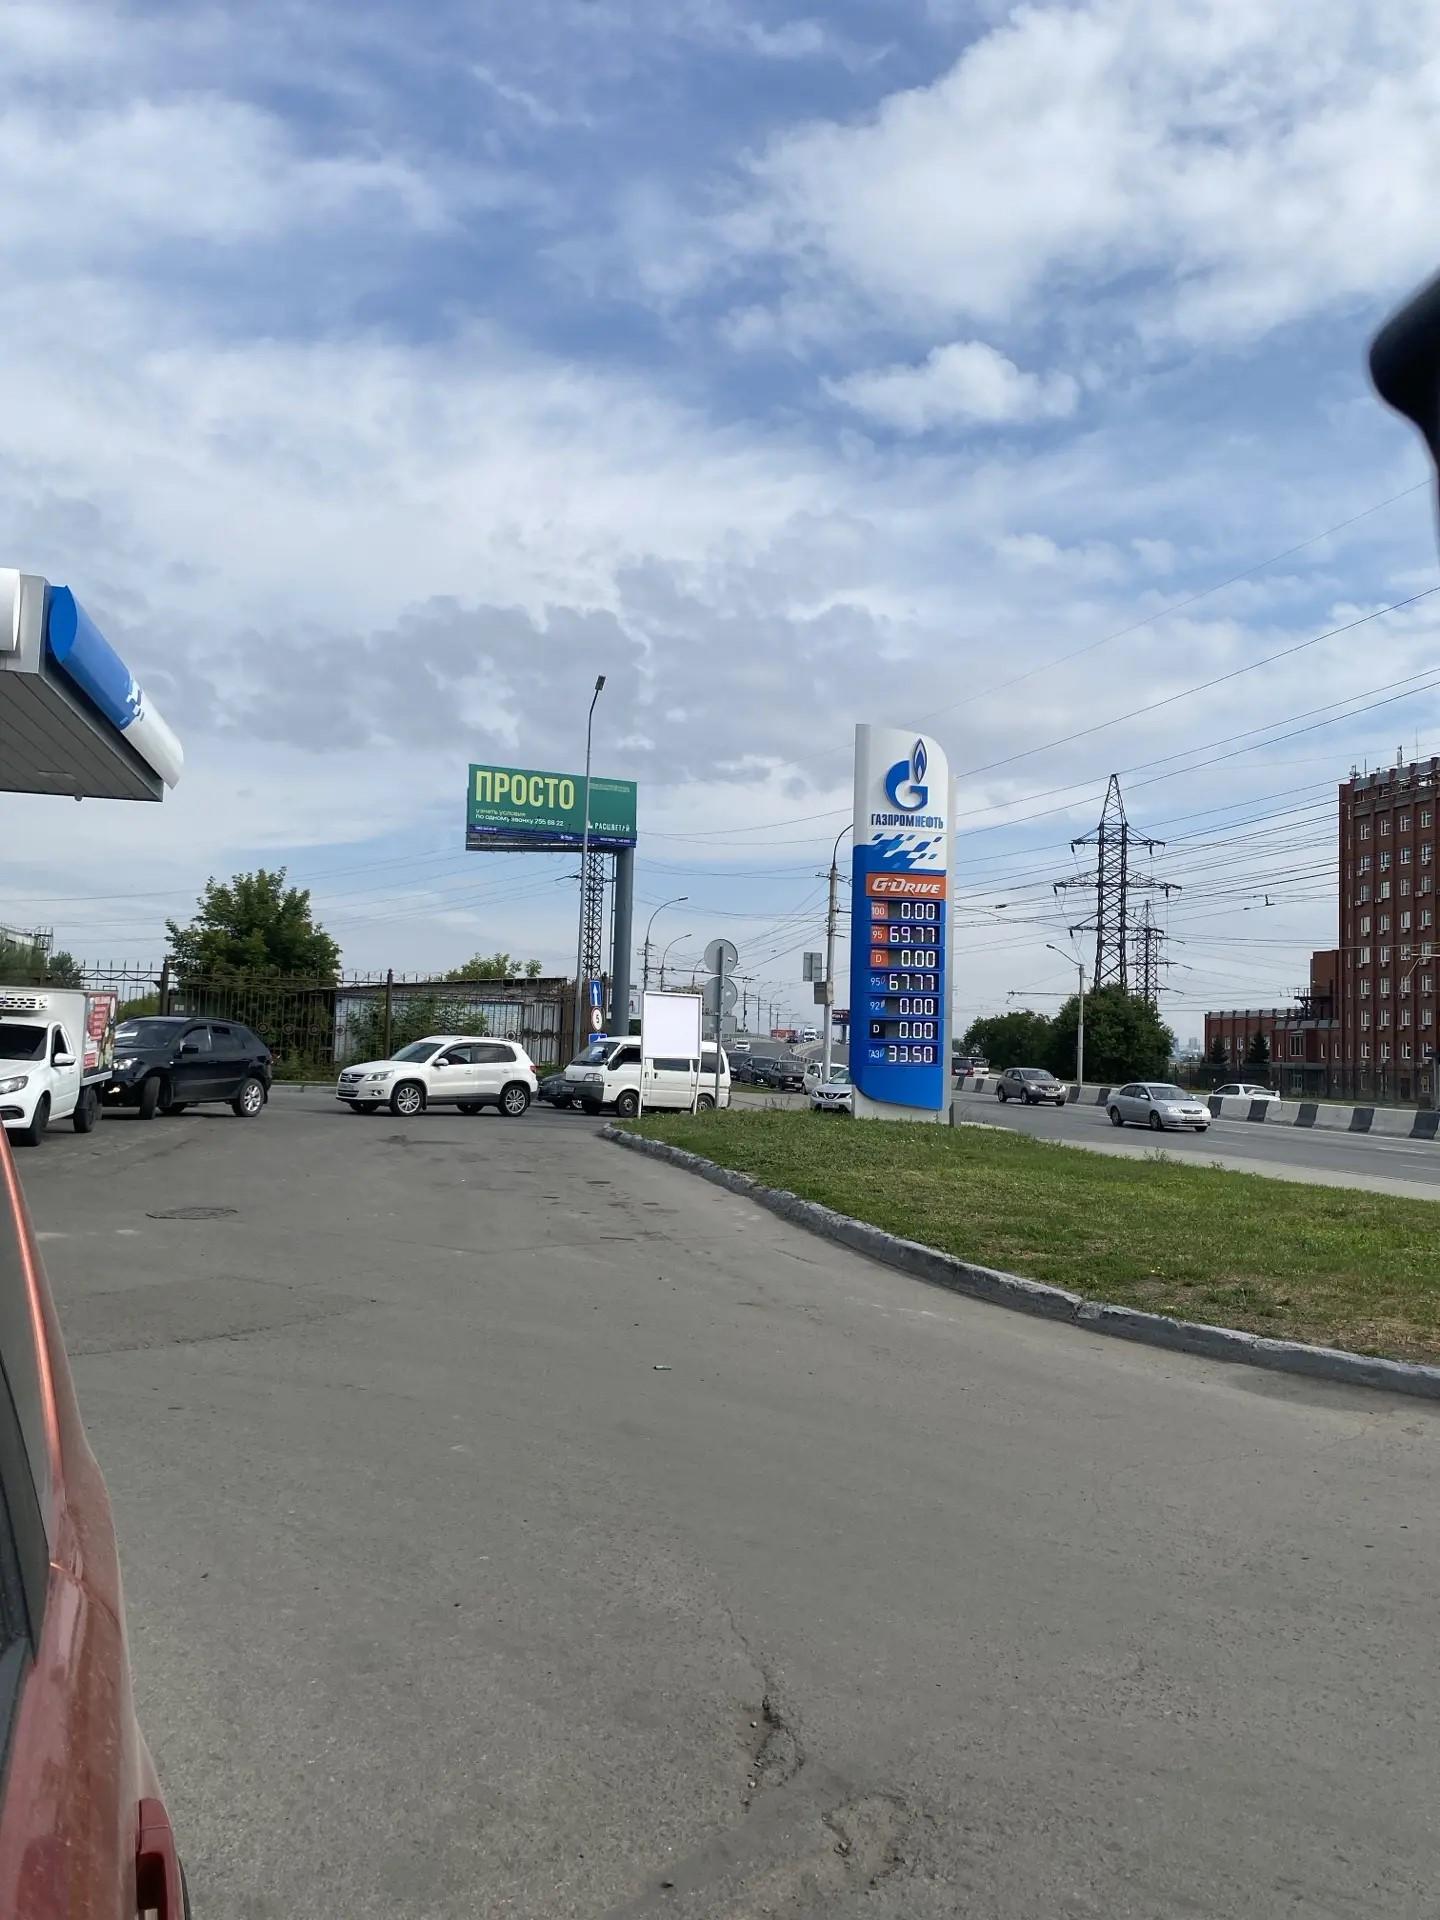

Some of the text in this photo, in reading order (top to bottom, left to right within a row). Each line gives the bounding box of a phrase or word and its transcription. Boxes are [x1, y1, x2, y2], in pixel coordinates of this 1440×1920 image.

[475, 770, 575, 810] ПРОСТО
[871, 813, 944, 829] ГАЗПРОМНЕФТЬ
[872, 902, 935, 920] 100 0.00
[872, 926, 935, 943] 95 69.77
[875, 950, 936, 968] D 0.00
[870, 973, 935, 991] 95 67.77
[869, 998, 934, 1015] 92 0.00
[872, 1022, 934, 1039] D 0.00
[888, 1045, 934, 1063] 33.50
